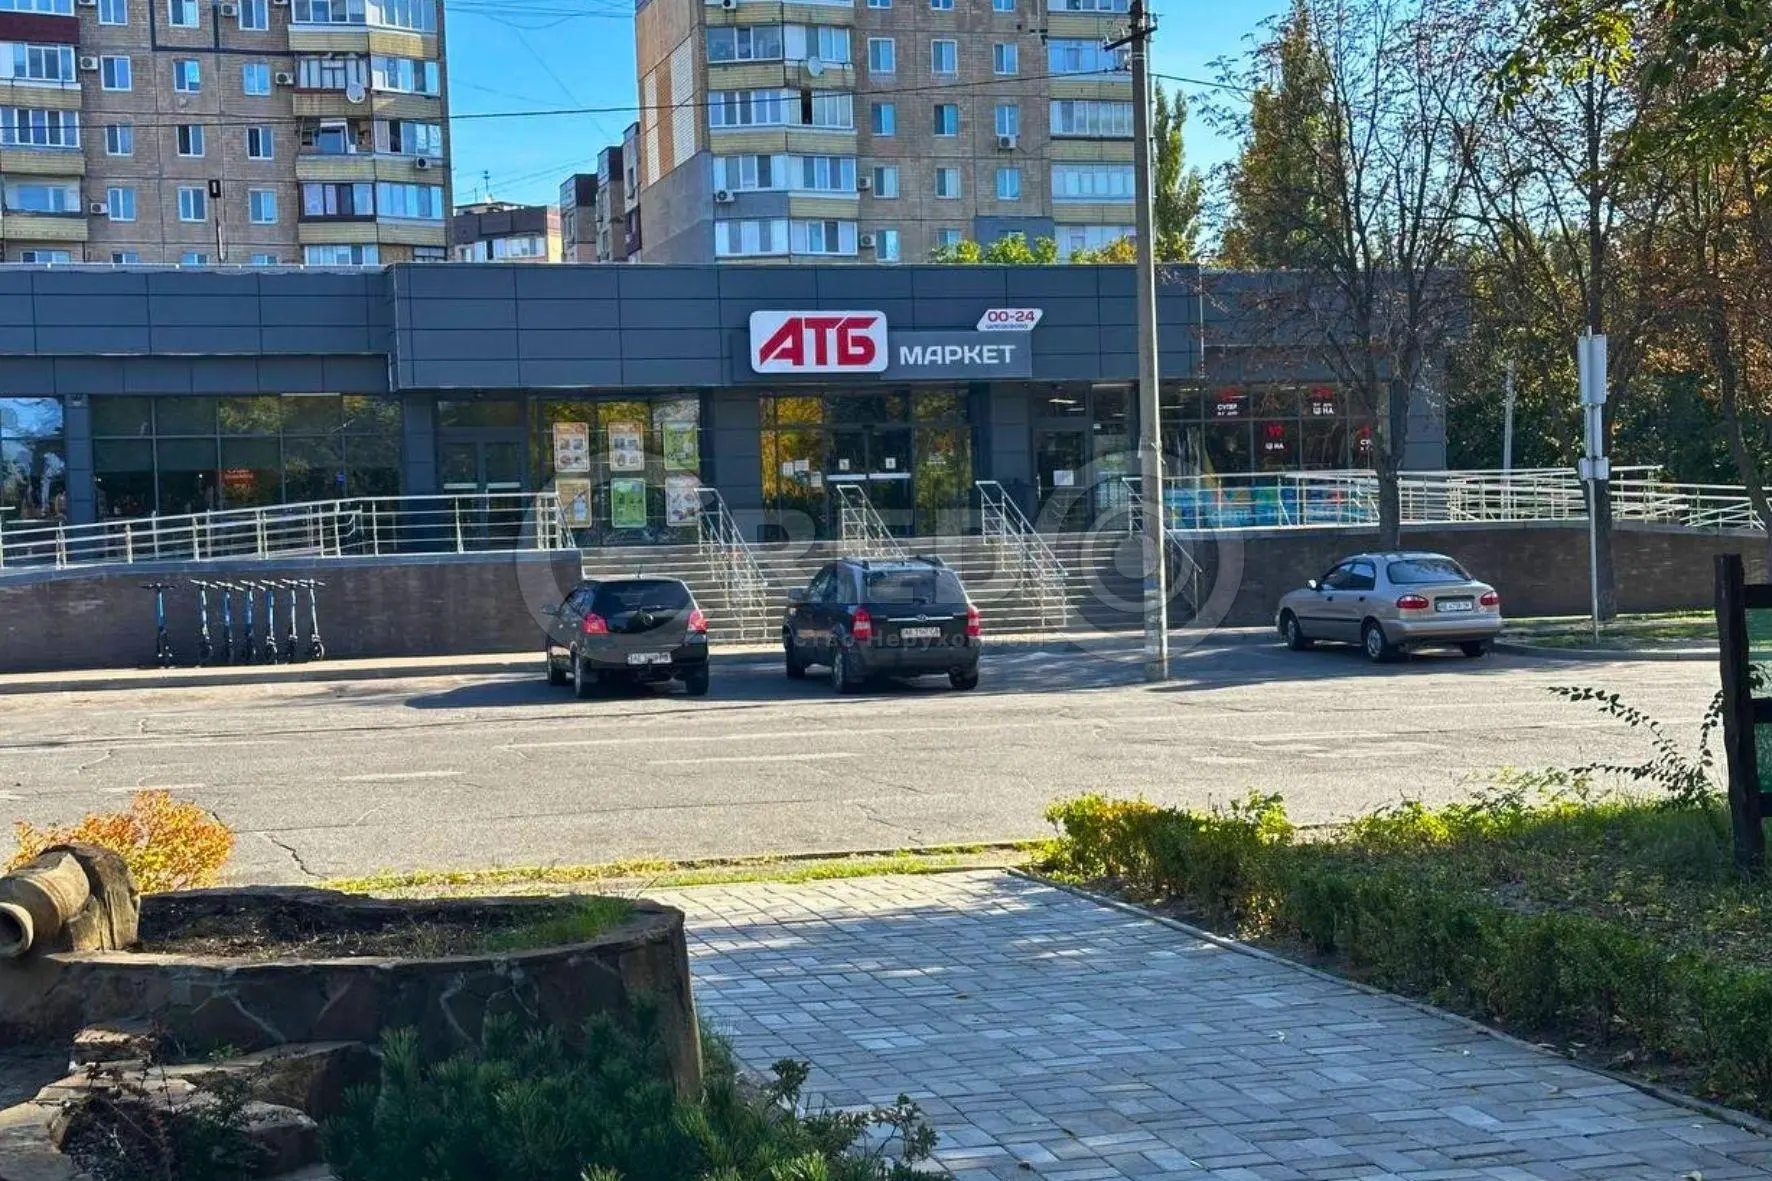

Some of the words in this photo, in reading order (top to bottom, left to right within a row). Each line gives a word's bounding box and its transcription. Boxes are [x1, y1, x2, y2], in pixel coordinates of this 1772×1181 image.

[987, 310, 1035, 322] 00-24
[759, 317, 879, 367] АТБ
[900, 345, 1017, 365] МАРКЕТ
